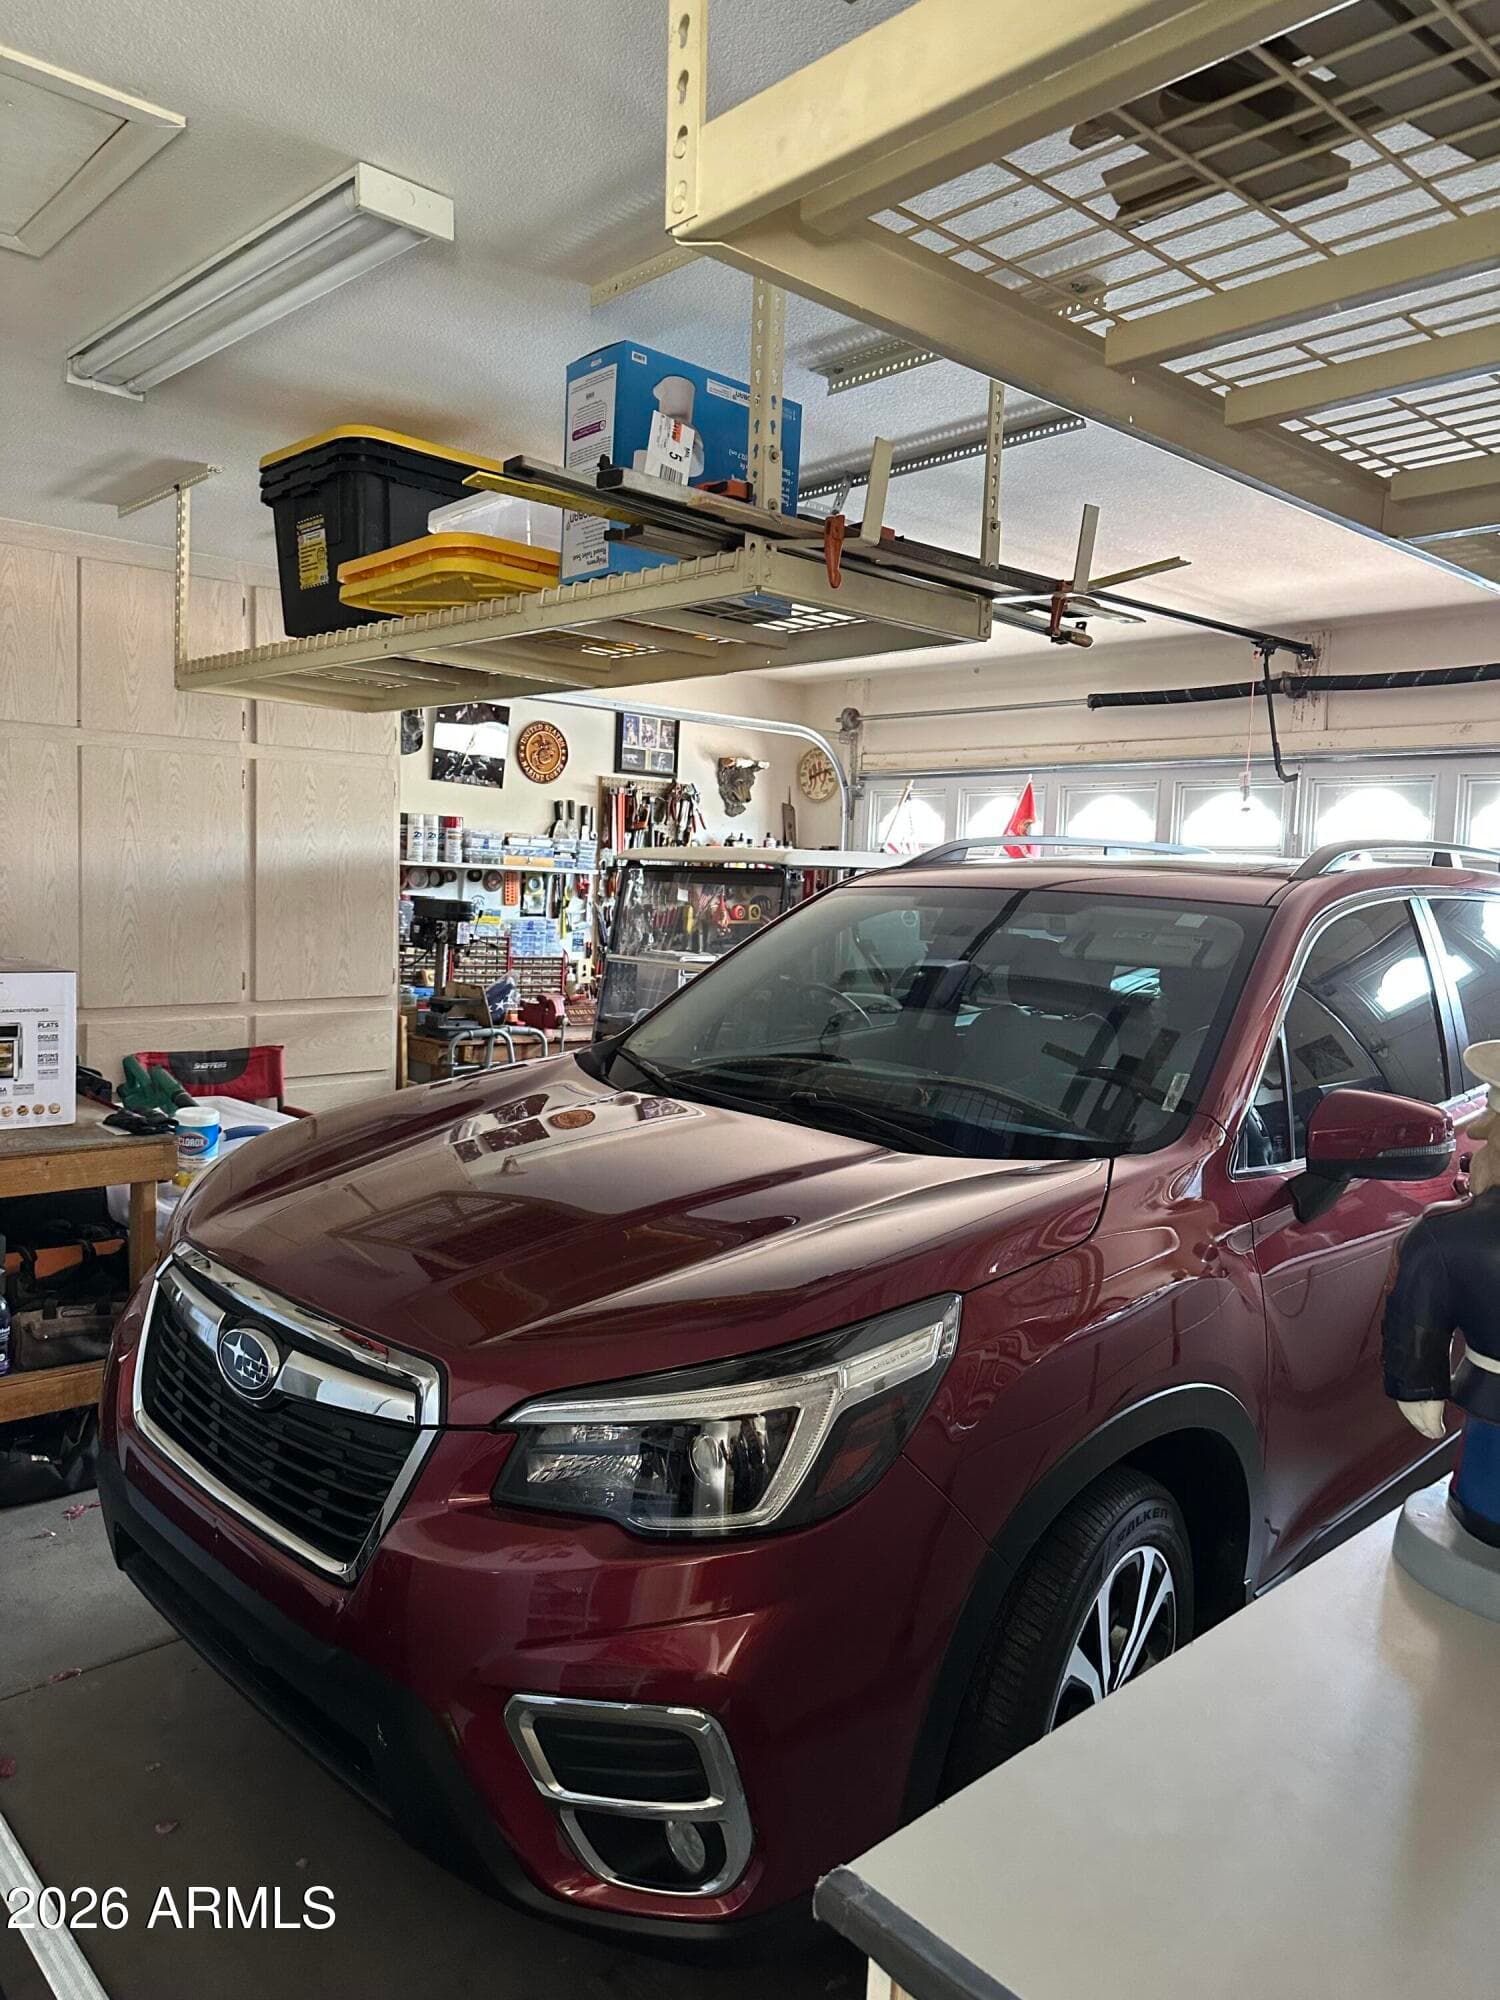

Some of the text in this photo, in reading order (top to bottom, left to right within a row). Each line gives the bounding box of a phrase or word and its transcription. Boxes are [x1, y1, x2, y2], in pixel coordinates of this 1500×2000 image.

[669, 450, 682, 462] 5
[520, 723, 566, 748] UNITED STATES
[520, 760, 564, 782] MARINE CORPS
[178, 1137, 205, 1147] CLOROX
[1118, 1508, 1168, 1547] FALKEN
